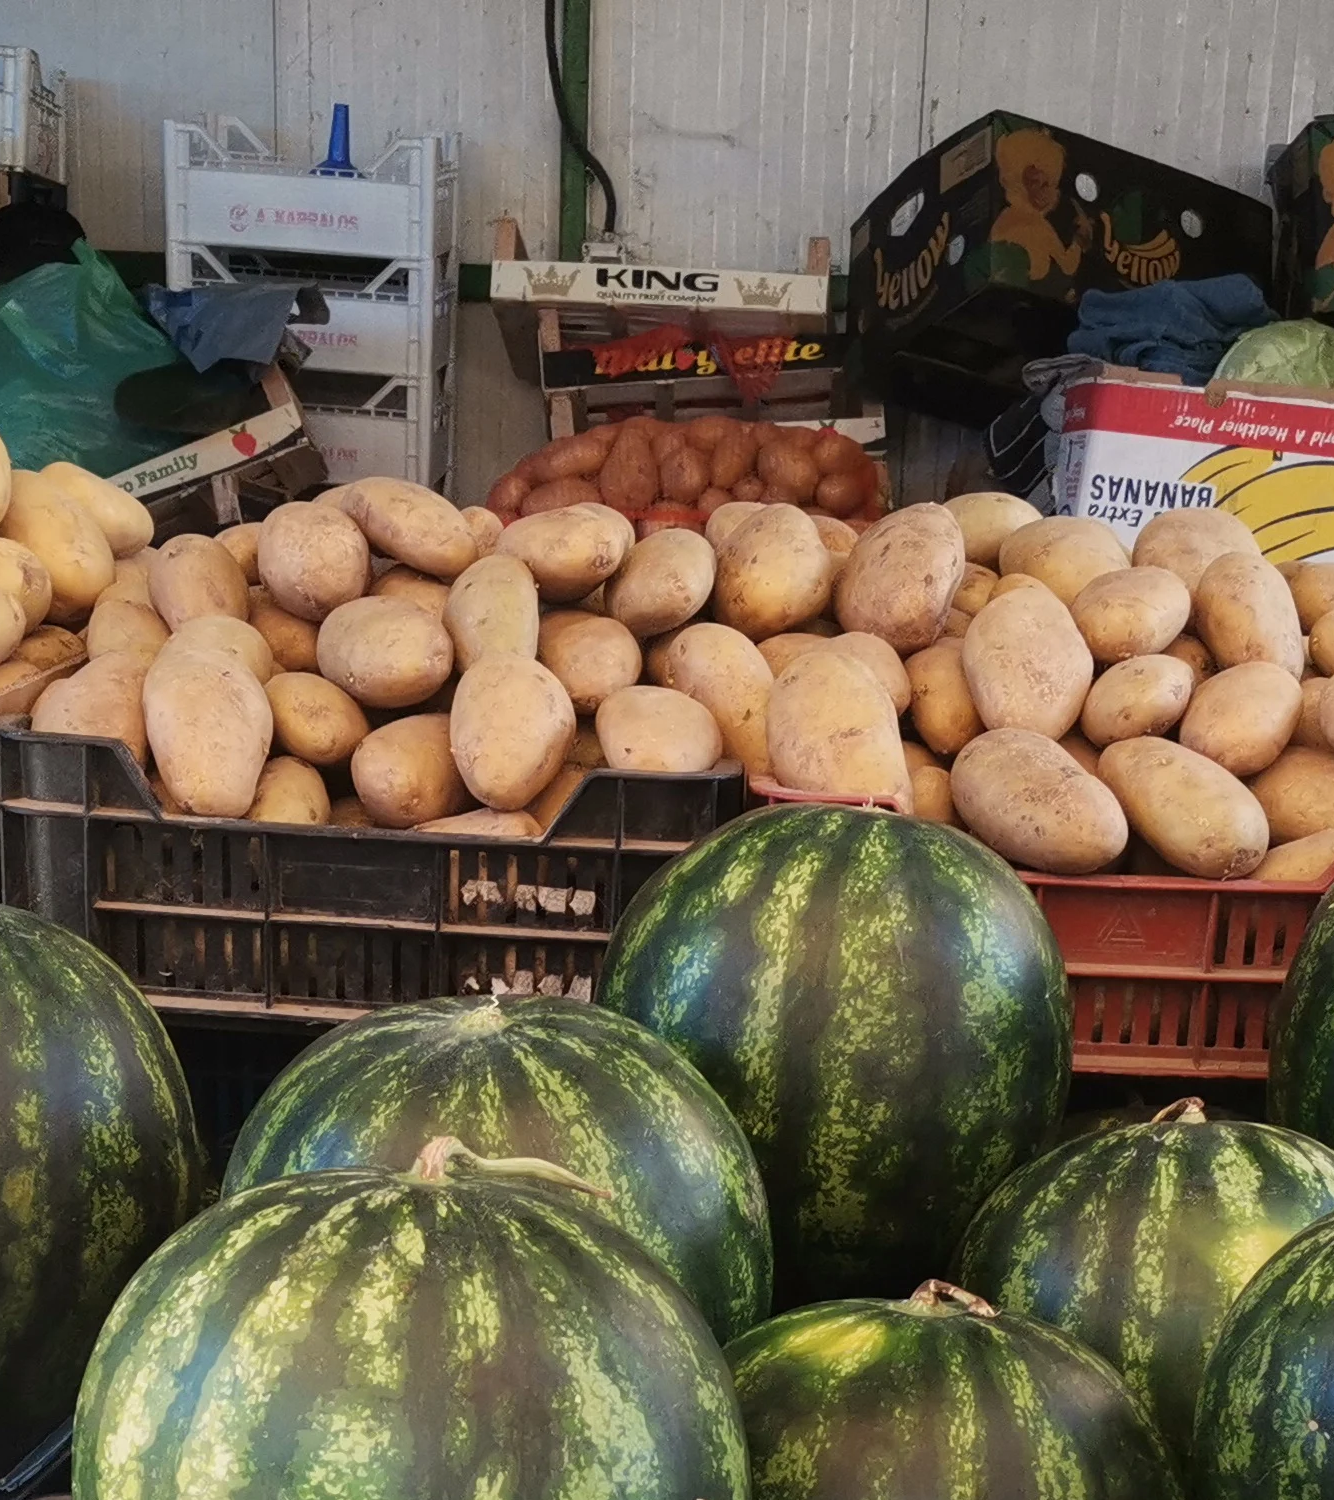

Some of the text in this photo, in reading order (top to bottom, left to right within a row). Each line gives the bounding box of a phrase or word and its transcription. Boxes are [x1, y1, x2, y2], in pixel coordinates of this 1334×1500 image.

[1100, 211, 1180, 285] yellow
[596, 268, 720, 293] KING
[597, 291, 636, 300] QUALITY
[667, 294, 716, 303] COMPANY
[1218, 417, 1287, 442] Healthier
[1294, 430, 1303, 442] A
[135, 452, 199, 489] Family
[1090, 474, 1214, 509] BANANAS
[1088, 503, 1143, 528] Extra
